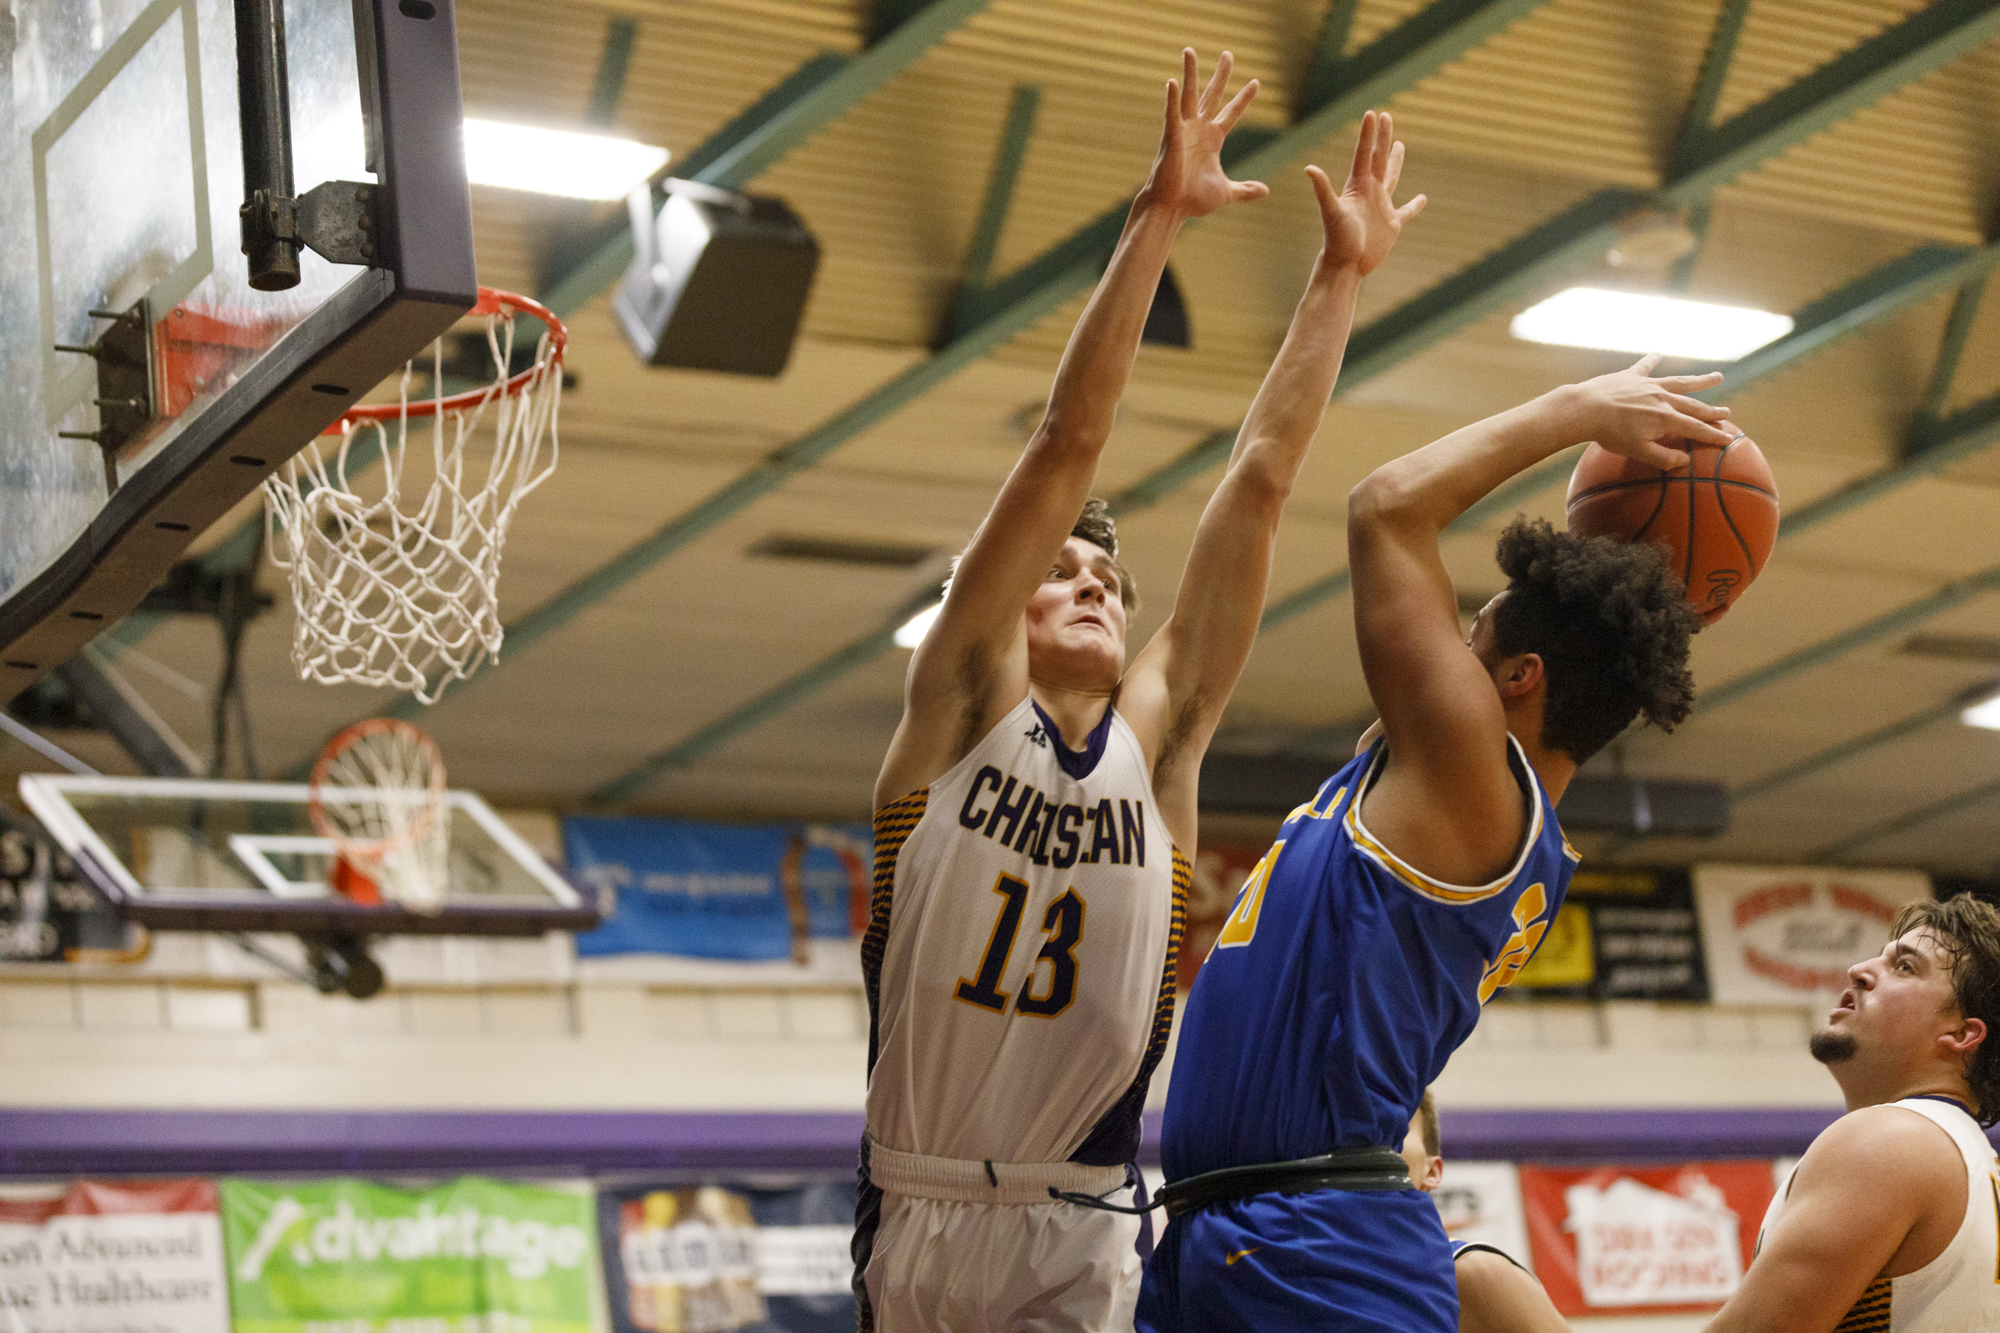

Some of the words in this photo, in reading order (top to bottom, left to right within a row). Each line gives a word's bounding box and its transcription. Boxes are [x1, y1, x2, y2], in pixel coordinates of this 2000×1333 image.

[958, 763, 1146, 870] CHRISAN
[953, 869, 1088, 1020] 13
[47, 1270, 214, 1308] Healthcare
